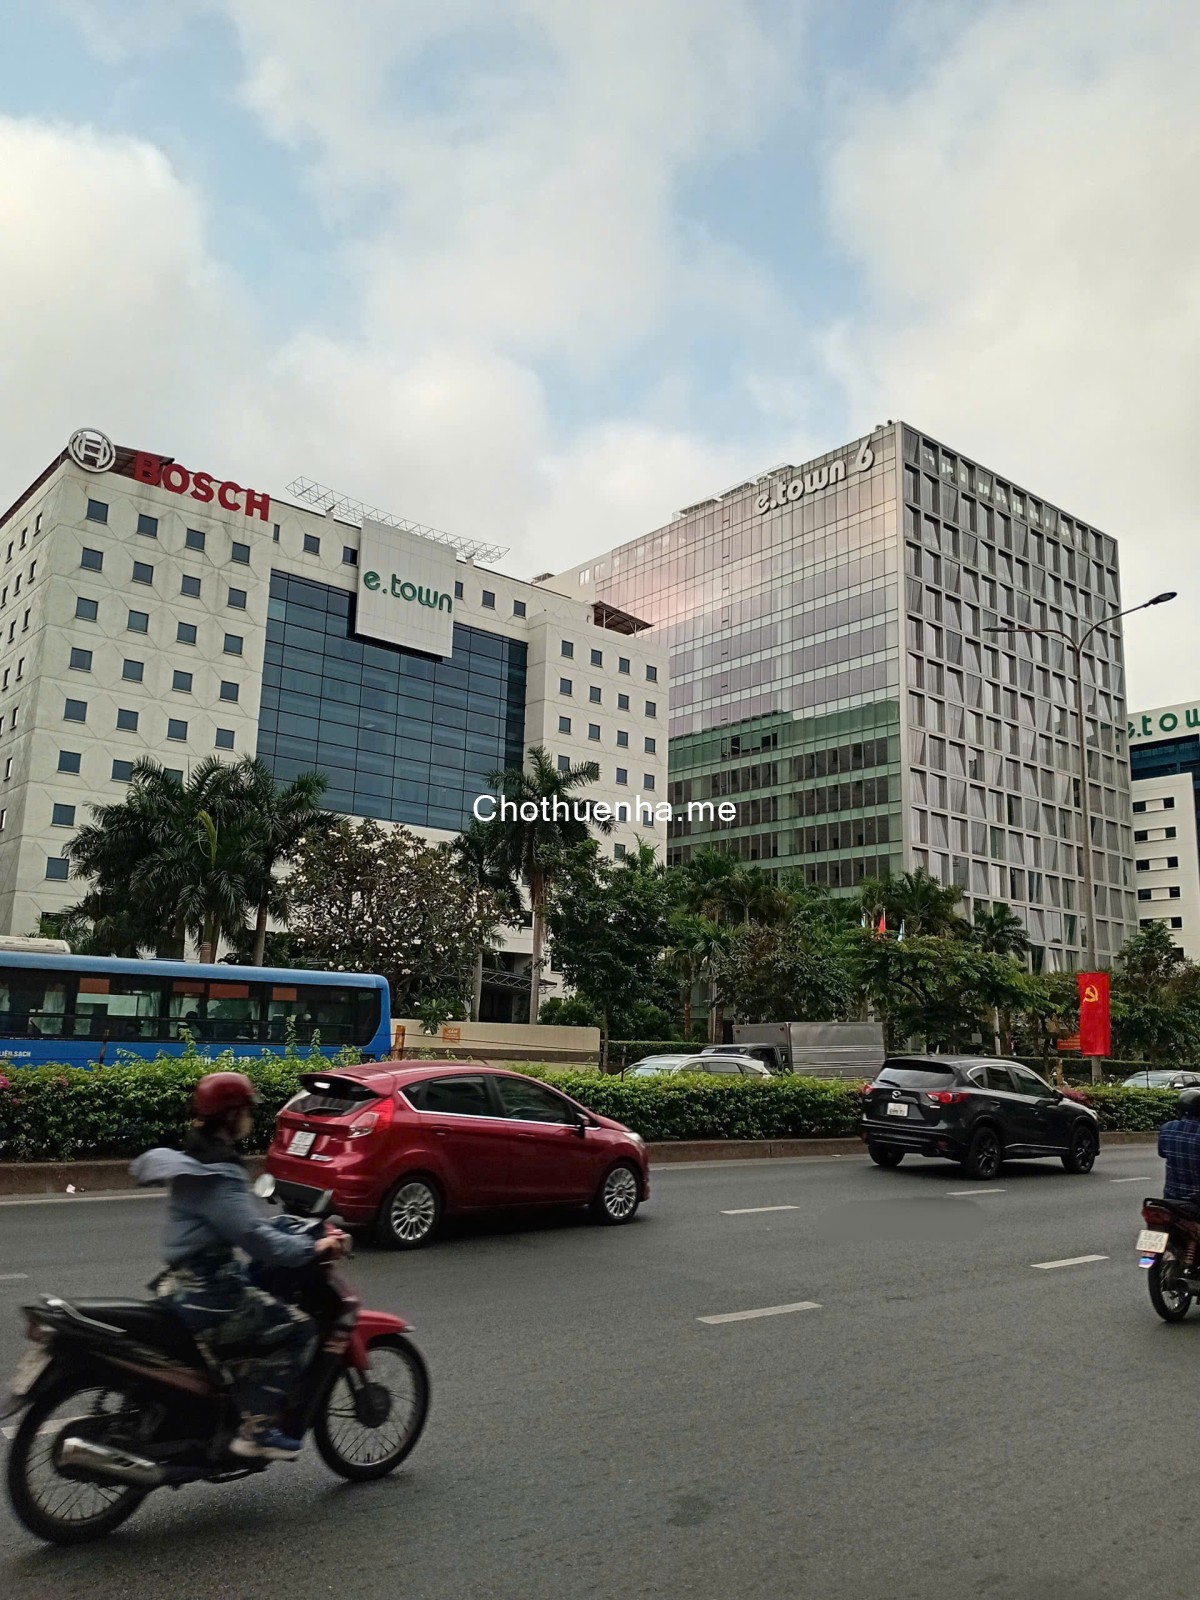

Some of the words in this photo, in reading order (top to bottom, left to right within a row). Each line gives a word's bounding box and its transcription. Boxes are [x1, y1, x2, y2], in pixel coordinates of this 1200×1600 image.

[133, 451, 270, 522] BOSCH
[754, 459, 847, 515] e.town
[855, 437, 875, 473] 6
[363, 570, 453, 614] e.town
